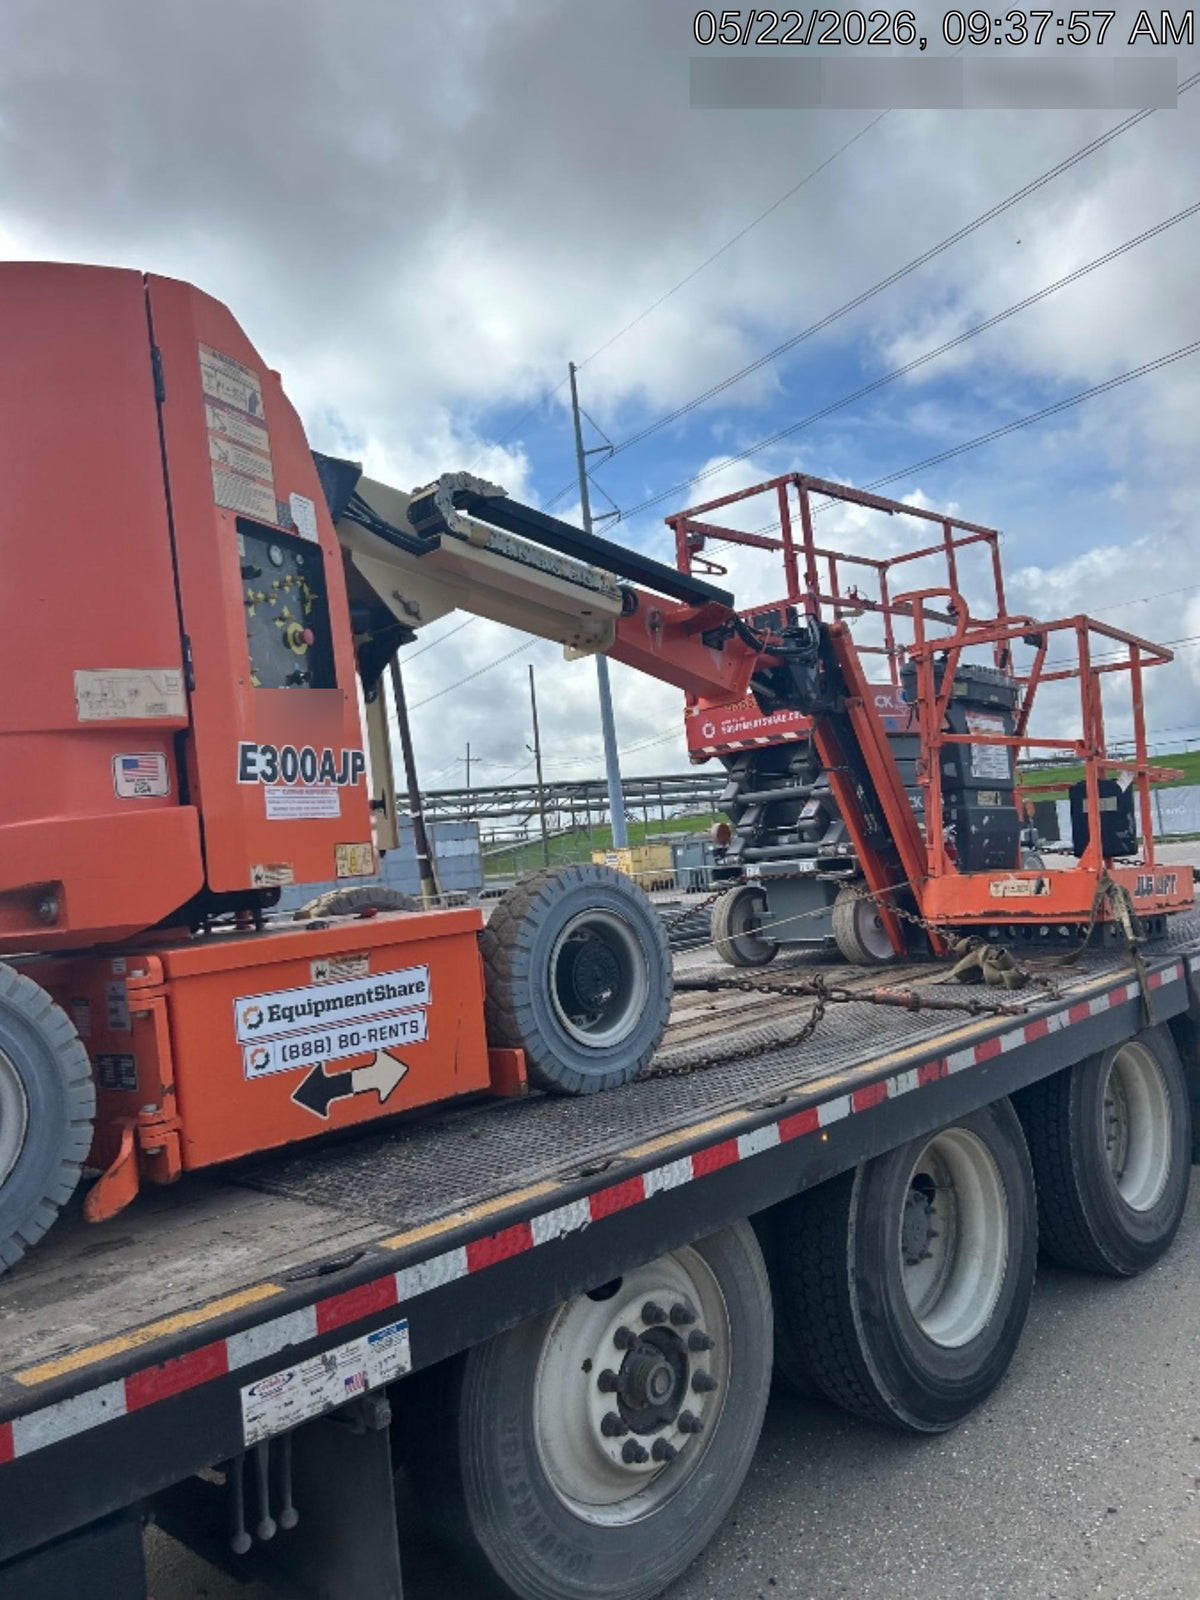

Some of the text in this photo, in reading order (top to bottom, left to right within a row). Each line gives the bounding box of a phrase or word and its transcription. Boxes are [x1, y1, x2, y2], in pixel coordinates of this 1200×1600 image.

[238, 743, 366, 785] E300AJP
[267, 980, 426, 1023] EquipmentShare
[281, 1020, 419, 1062] (888) 80-RENTS
